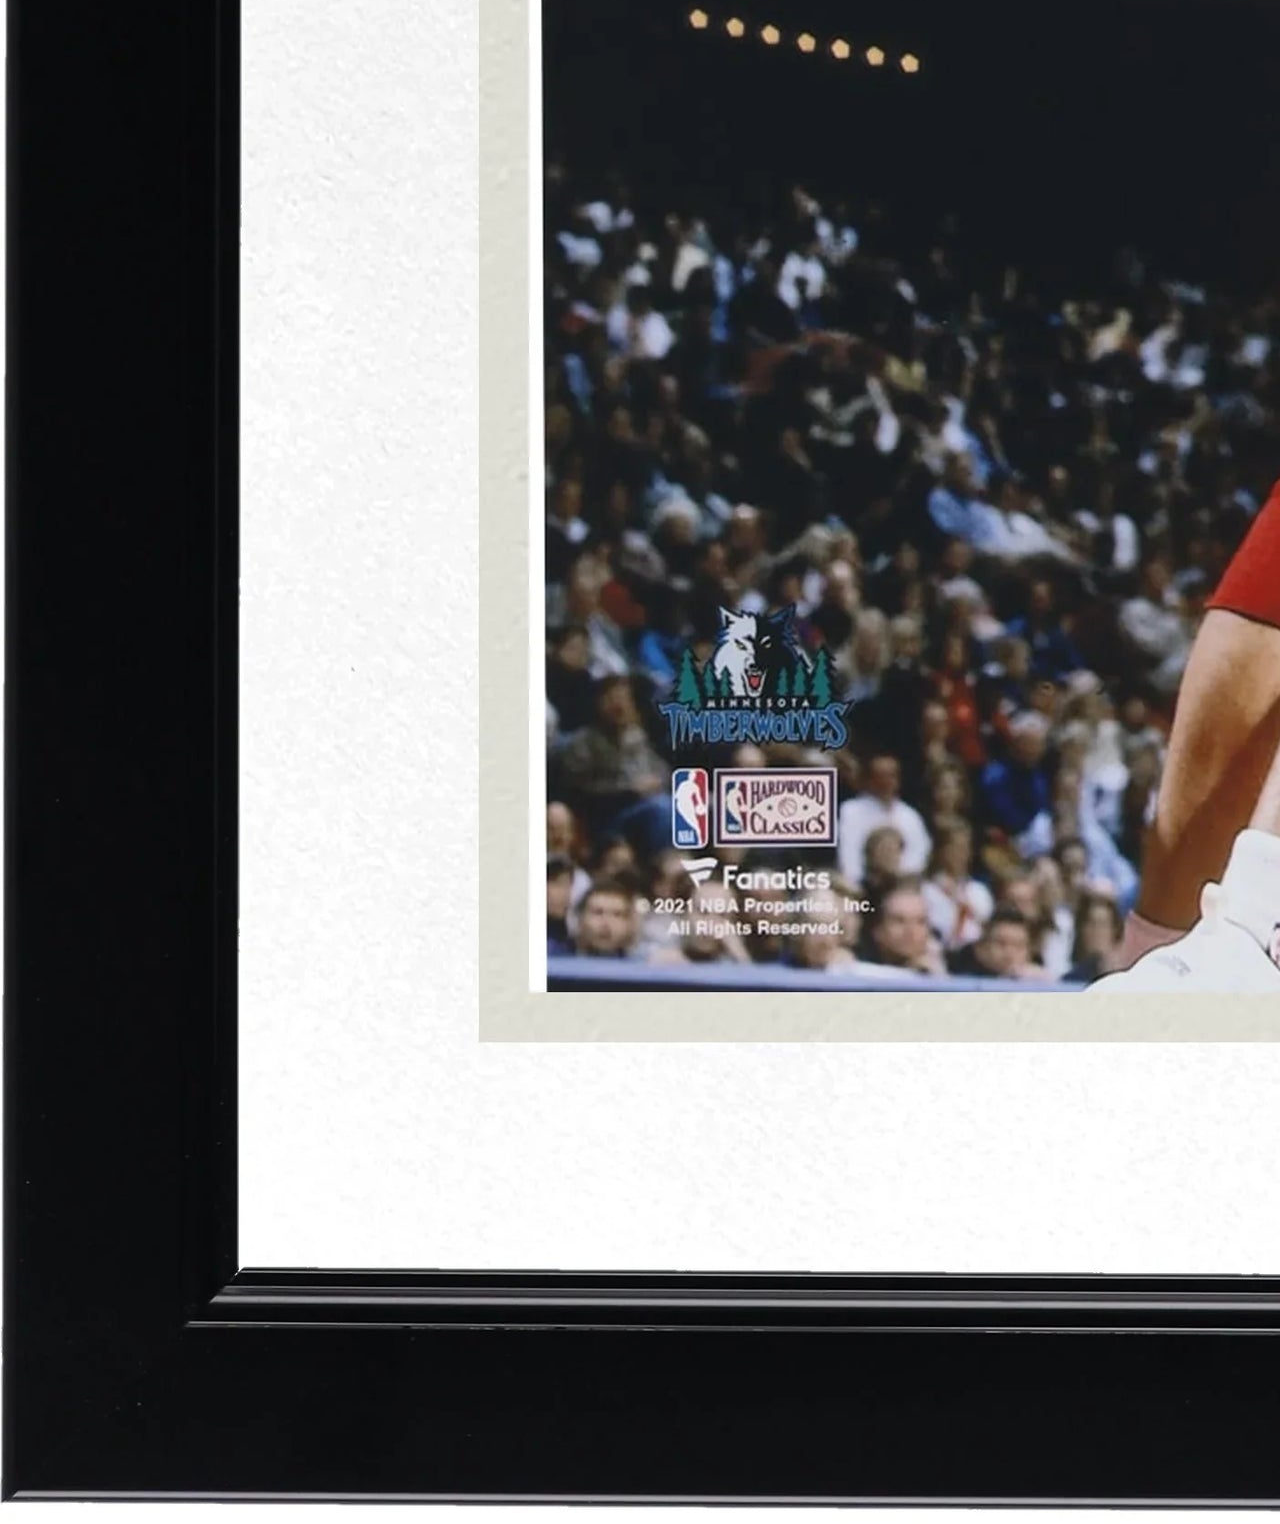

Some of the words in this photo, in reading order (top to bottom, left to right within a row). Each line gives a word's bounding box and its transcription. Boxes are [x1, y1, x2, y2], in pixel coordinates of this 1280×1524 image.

[706, 698, 811, 708] MINNESOTA
[658, 702, 851, 751] TIMBERWOLVES
[750, 780, 826, 810] HARDWOOD
[750, 812, 826, 835] CLASSICS
[677, 829, 696, 844] NBA
[722, 865, 832, 890] Fanatics
[654, 898, 695, 913] 2021
[699, 898, 739, 913] NBA
[744, 898, 838, 918] Properties,
[844, 898, 876, 913] Inc.
[668, 920, 691, 935] All
[695, 920, 752, 939] Rights
[758, 920, 844, 935] Reserved.
